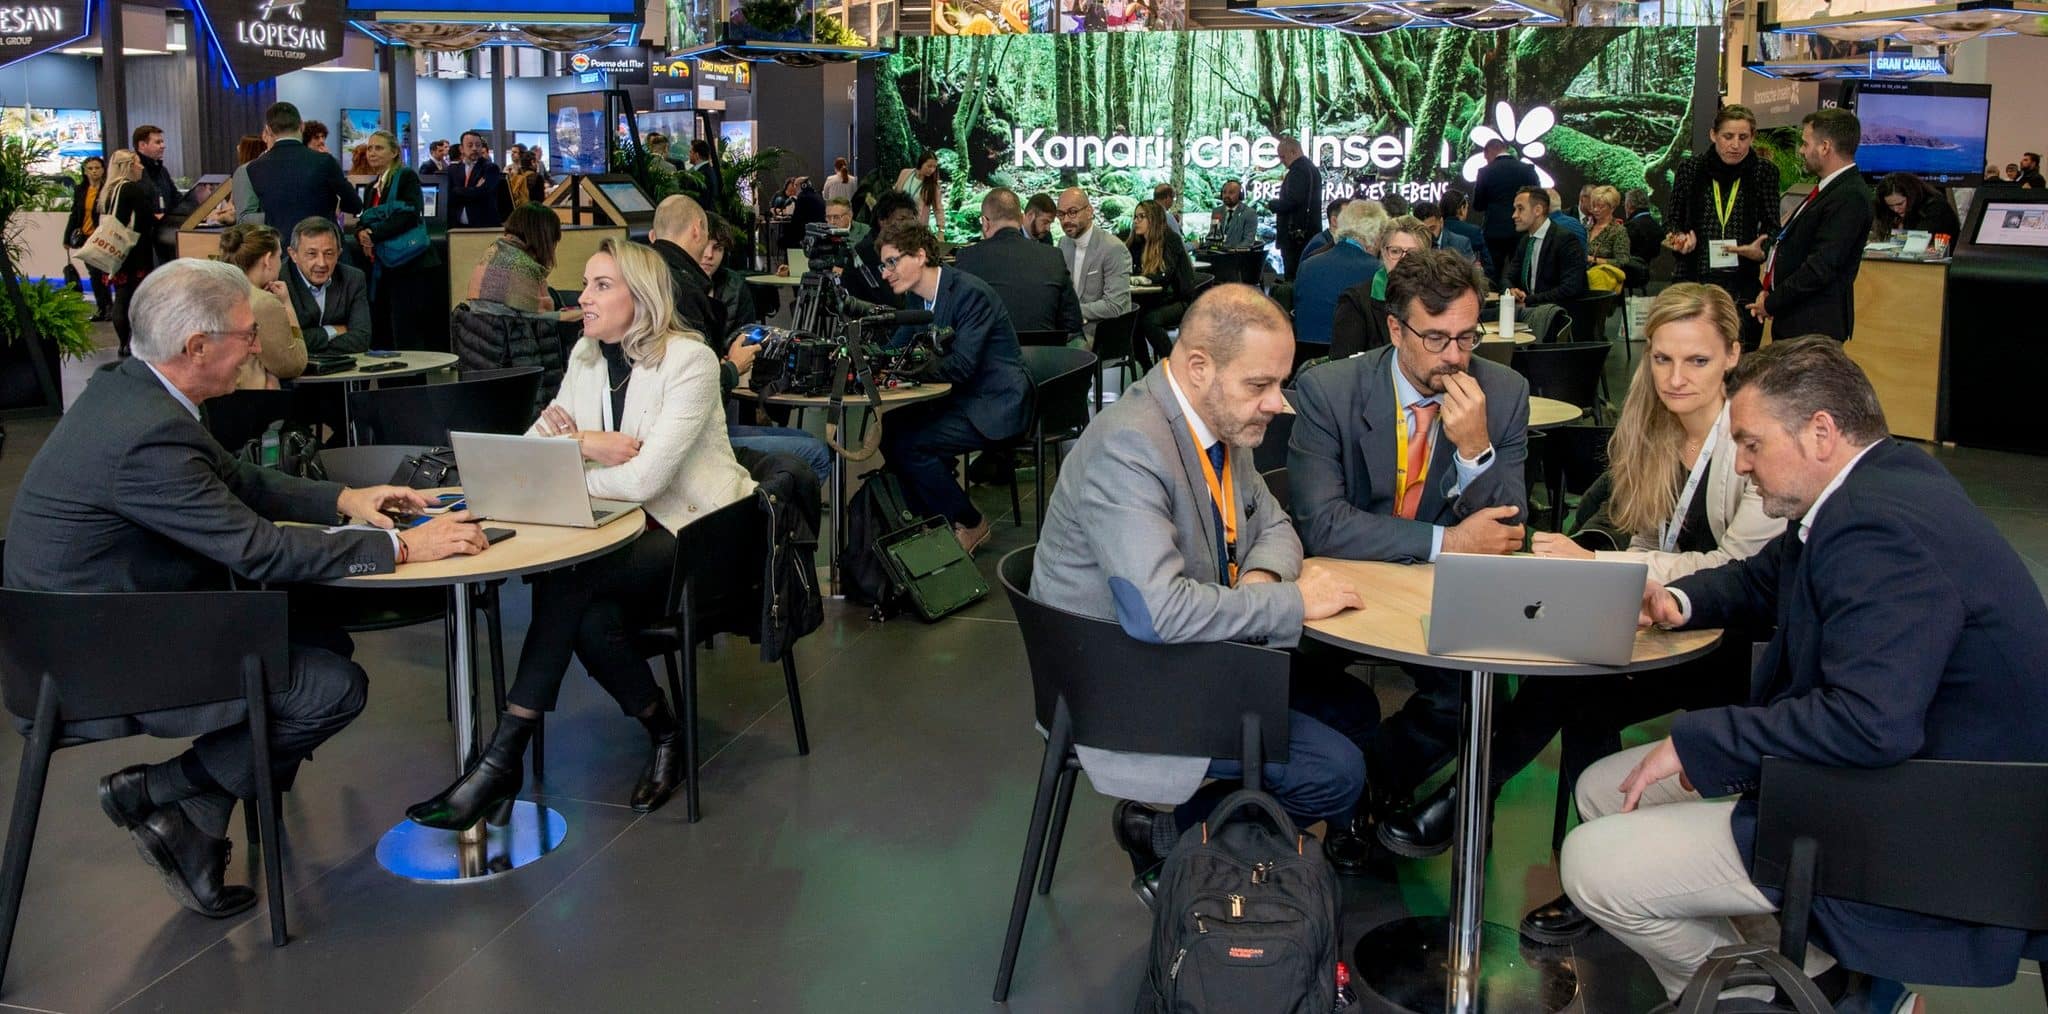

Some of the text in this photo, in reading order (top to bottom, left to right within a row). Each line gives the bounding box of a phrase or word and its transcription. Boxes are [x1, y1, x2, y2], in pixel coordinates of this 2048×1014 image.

[0, 6, 62, 32] ESAN
[6, 36, 33, 46] GROUP
[238, 20, 326, 50] LOPESAN
[264, 48, 306, 59] HOTEL GROUP
[590, 59, 616, 68] Poema
[617, 59, 628, 68] del
[629, 60, 644, 68] Mar
[1876, 57, 1940, 71] GRAN CANARIA
[1301, 127, 1449, 168] Insel
